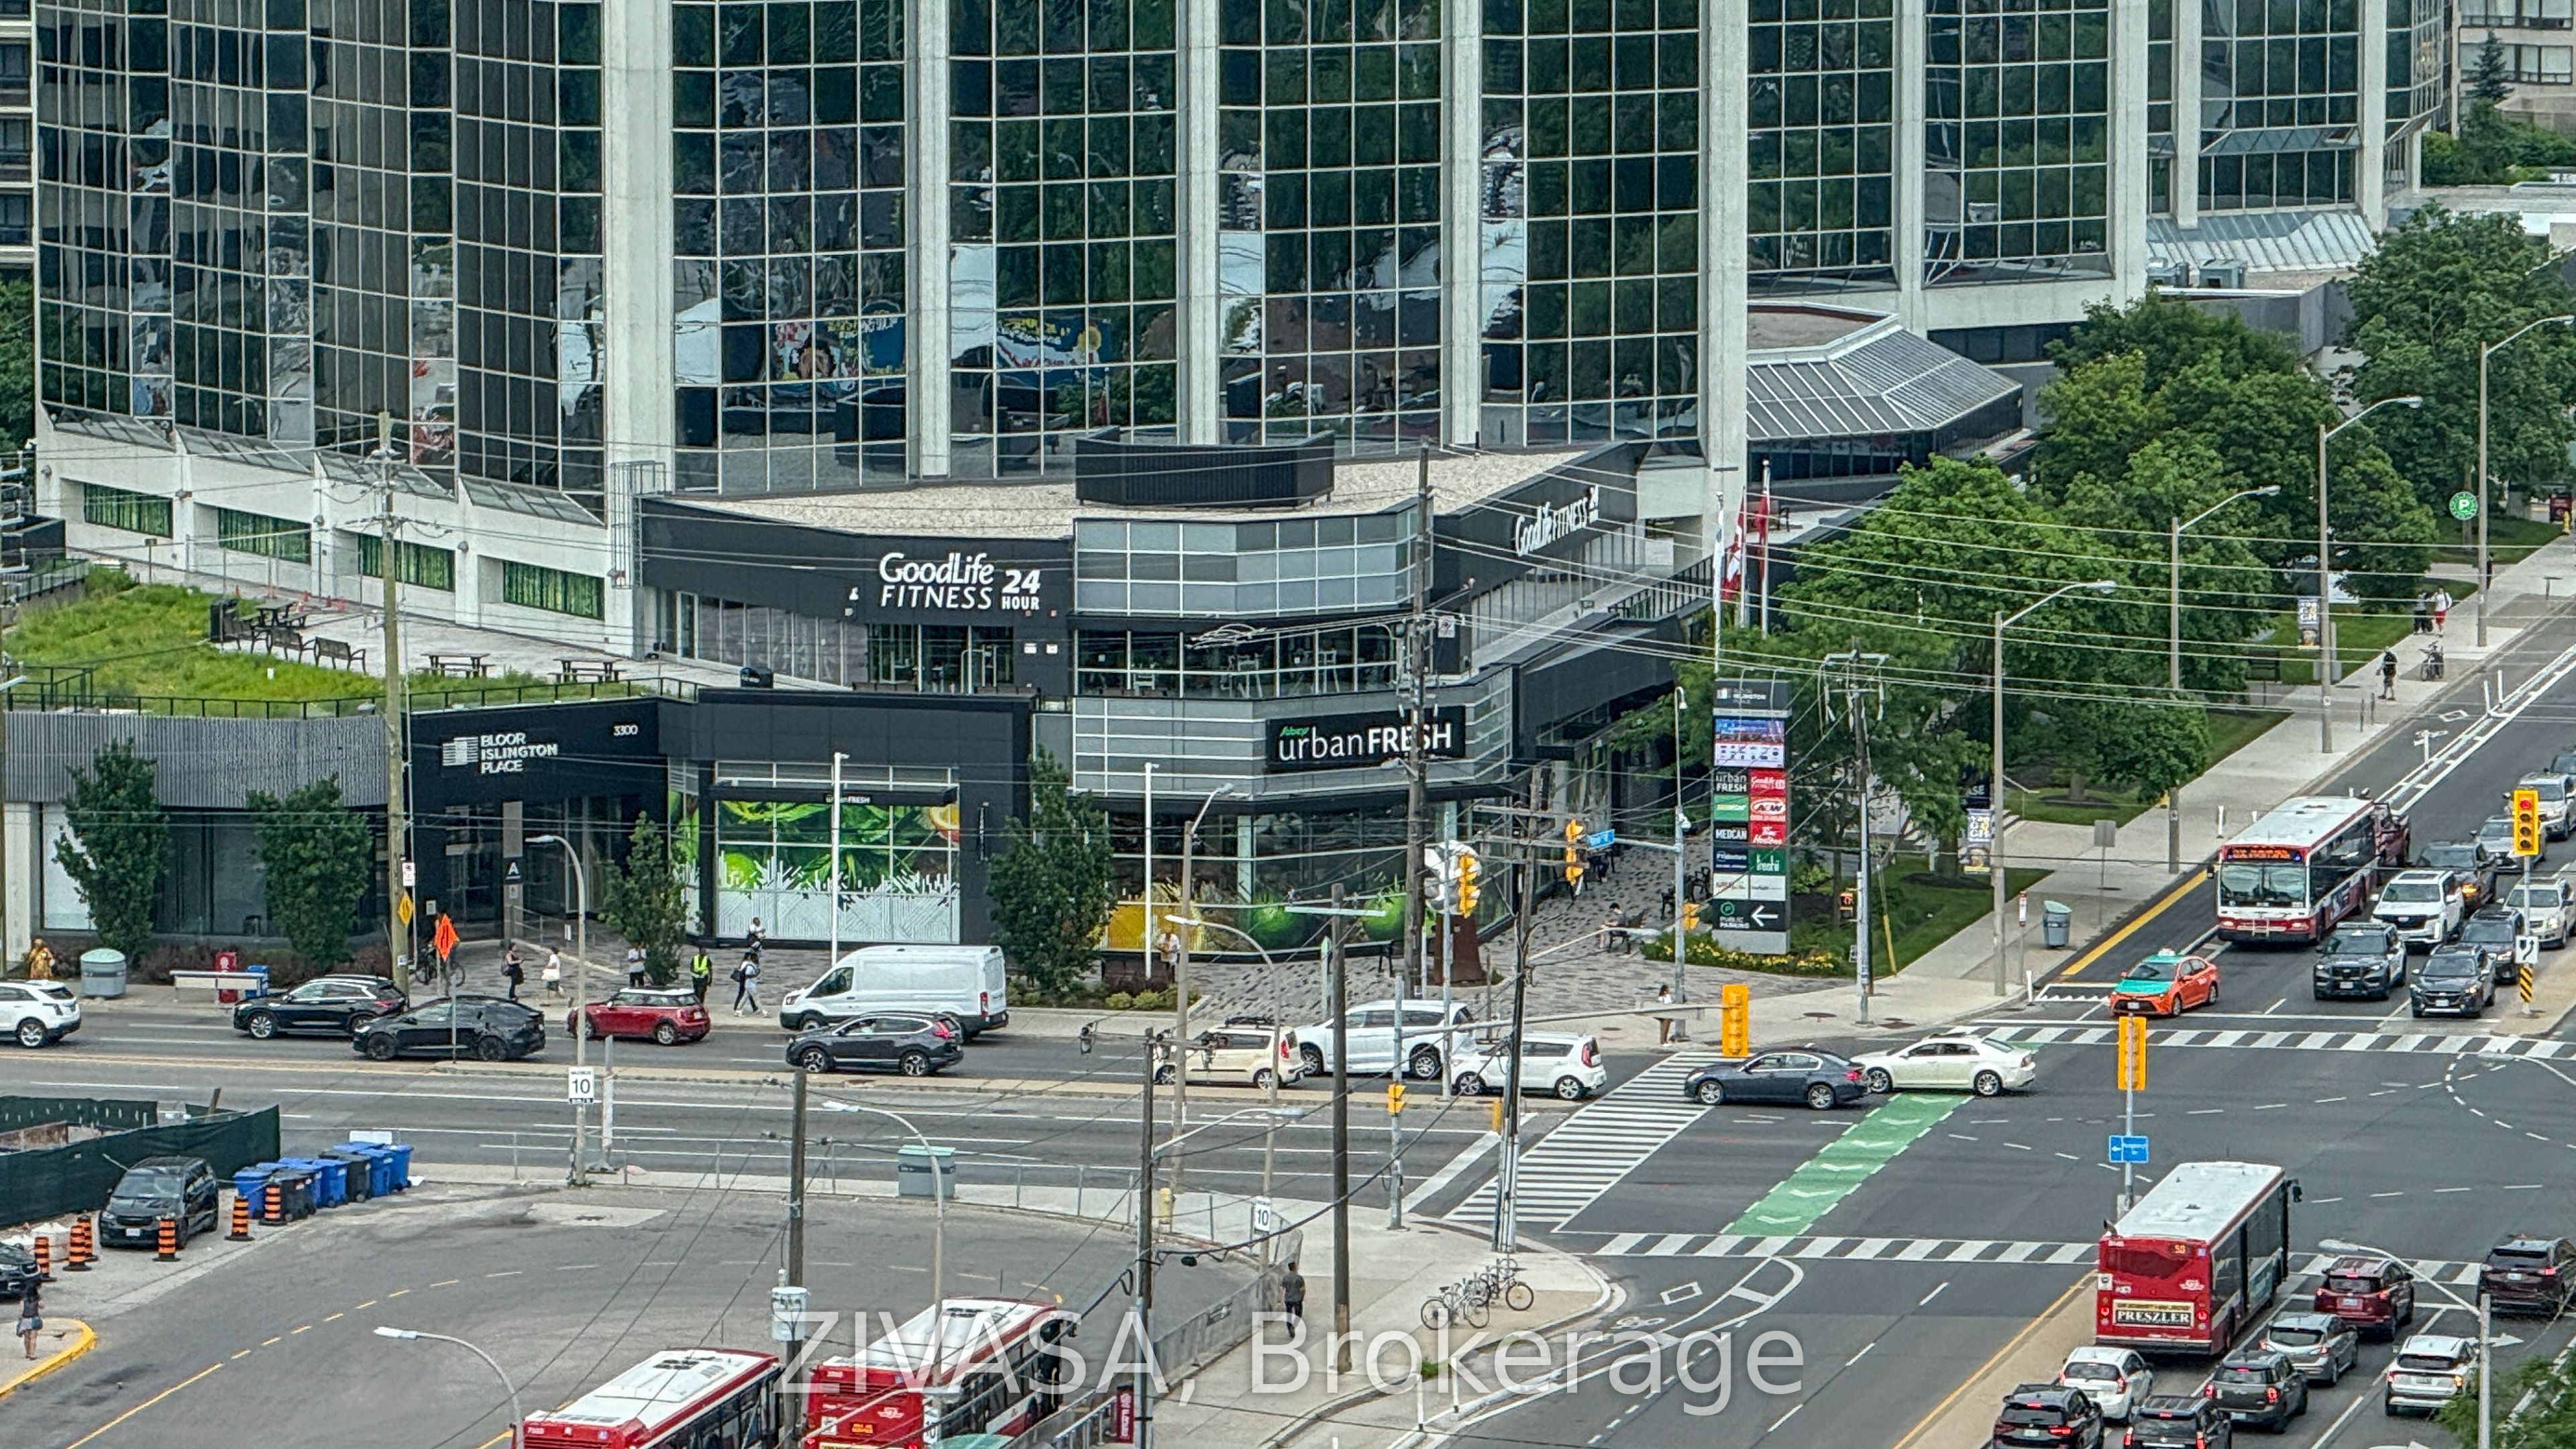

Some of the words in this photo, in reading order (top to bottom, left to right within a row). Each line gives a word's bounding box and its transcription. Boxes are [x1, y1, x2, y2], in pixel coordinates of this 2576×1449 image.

[879, 552, 994, 584] GoodLife
[1002, 570, 1041, 594] 24
[880, 584, 993, 610] FITNESS
[1001, 596, 1040, 610] HOUR
[480, 733, 526, 747] BLOOR
[480, 744, 558, 761] ISLINGTON
[480, 759, 524, 774] PLACE
[1716, 782, 1747, 792] FRESH
[1715, 828, 1747, 840] MEDCAN
[508, 861, 519, 875] A
[572, 1078, 590, 1093] 10
[1258, 1209, 1269, 1226] 10
[2117, 1310, 2190, 1324] PRESZLER
